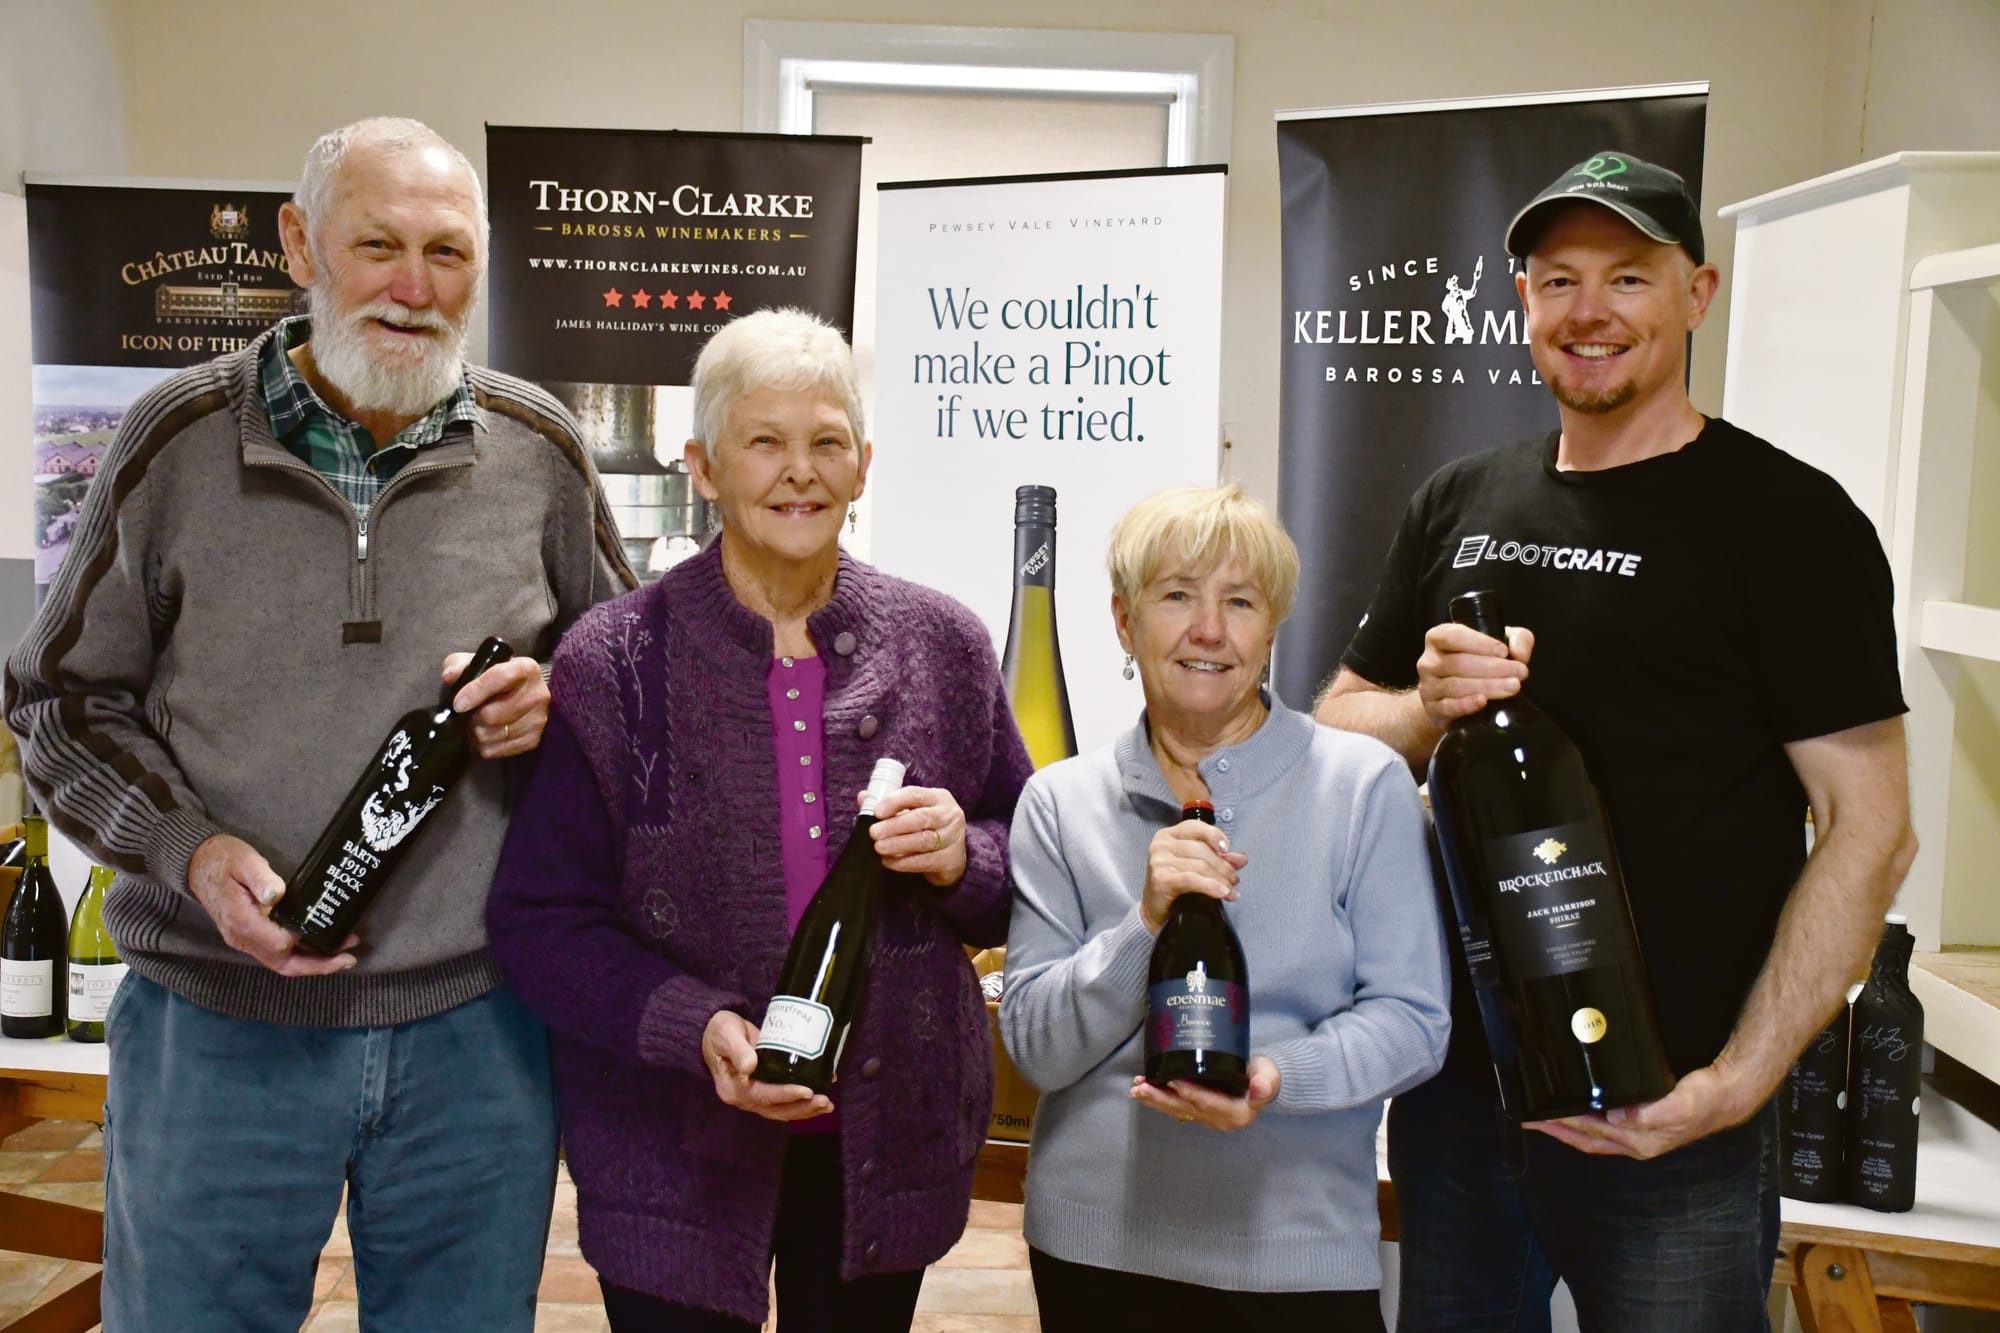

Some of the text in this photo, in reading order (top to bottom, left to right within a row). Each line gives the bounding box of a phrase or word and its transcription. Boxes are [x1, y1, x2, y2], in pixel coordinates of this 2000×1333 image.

[1607, 181, 1628, 191] heart
[529, 180, 814, 219] THORN-CLARKE
[561, 222, 781, 242] BAROSSA WINEMAKERS
[929, 216, 1162, 232] PEWSEY VALE VINEYARD
[121, 242, 290, 285] CHÂTEAU TANU
[528, 257, 807, 276] WWW.THORNCLARKEWINES.COM.AU
[1348, 257, 1439, 292] SINCE
[927, 283, 1159, 330] We couldn't
[226, 316, 271, 327] AUSTR
[555, 319, 592, 330] JAMES
[596, 320, 665, 333] HALLIDAY'S
[669, 322, 700, 333] WINE
[1294, 310, 1435, 345] KELLER
[121, 335, 249, 352] ICON OF THE
[914, 340, 1172, 386] make a Pinot
[1325, 367, 1543, 385] BAROSSA VAL
[937, 394, 1144, 442] if we tried.
[1020, 541, 1049, 577] PEWSEY
[1028, 554, 1050, 576] VALE
[1484, 540, 1643, 577] LOOTCRATE
[342, 840, 381, 869] BART'S
[326, 864, 364, 892] BLOCK
[339, 857, 367, 878] 1919
[1498, 862, 1607, 893] BROCKENCHACK
[1526, 899, 1596, 918] JACK HARRISON
[1549, 912, 1581, 925] SHIRAZ
